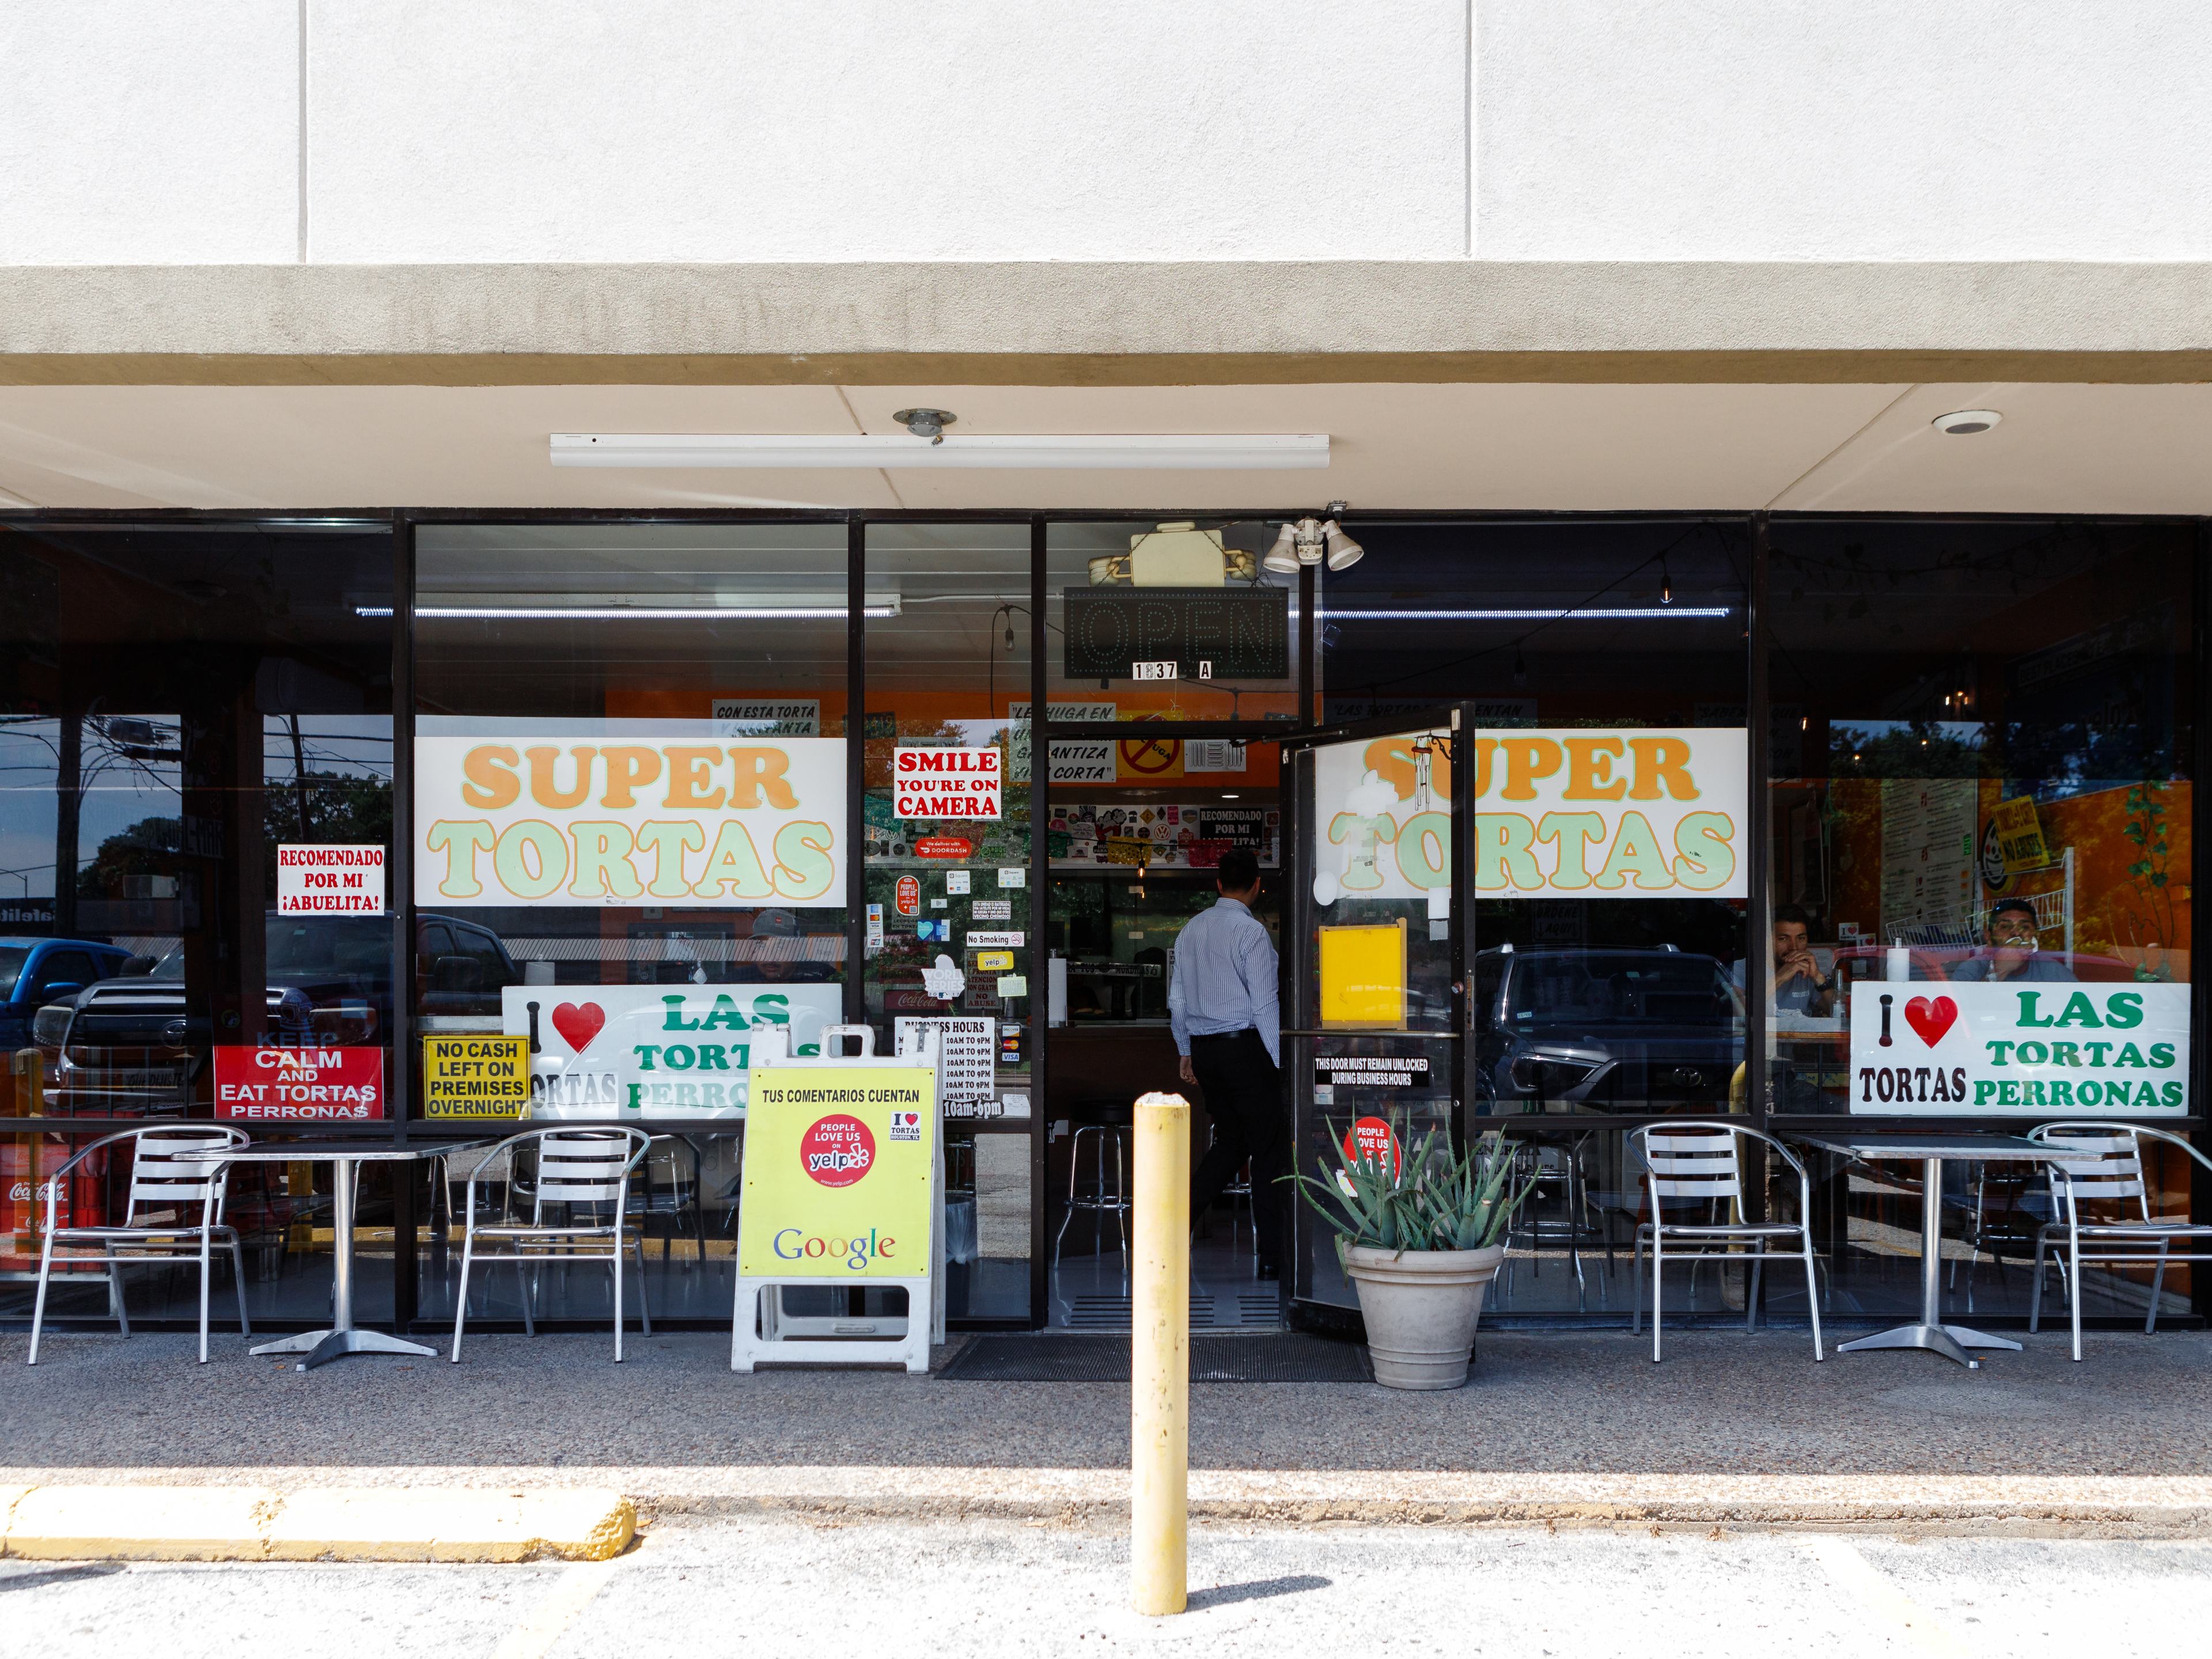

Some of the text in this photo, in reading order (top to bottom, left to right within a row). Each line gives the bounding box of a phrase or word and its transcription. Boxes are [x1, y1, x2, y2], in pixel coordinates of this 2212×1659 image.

[1081, 602, 1271, 664] OPEN
[1201, 663, 1209, 677] A
[717, 706, 815, 718] CON ESTA TORTA
[1013, 707, 1113, 719] "LEHUGA EN
[1017, 747, 1108, 759] GANTIZA
[899, 752, 997, 772] SMILE
[1363, 736, 1702, 802] SUPER
[461, 744, 800, 810] SUPER
[897, 780, 998, 791] YOU'RE ON
[897, 797, 997, 816] CAMERA
[1201, 811, 1262, 821] RECOMENDADO
[1215, 825, 1250, 834] POR MI
[281, 850, 383, 866] RECOMENDADO
[1327, 810, 1736, 891] TORTAS
[426, 819, 835, 900] TORTAS
[305, 873, 362, 888] POR MI
[283, 896, 378, 911] ¡ABUELITA!
[979, 935, 1009, 945] Smoking
[925, 980, 965, 991] SERIES
[662, 994, 790, 1031] LAS
[2016, 991, 2143, 1029] LAS
[527, 1001, 540, 1054] I
[953, 1022, 984, 1033] HOURS
[1878, 994, 1893, 1047] I
[257, 1032, 339, 1049] KEEP
[977, 1037, 990, 1045] 9PM
[437, 1043, 517, 1058] NO CASH
[1986, 1041, 2176, 1069] TORTAS
[256, 1051, 342, 1069] CALM
[1316, 1058, 1428, 1071] THIS DOOR MUST REMAIN UNLOCKED
[277, 1070, 318, 1081] AND
[439, 1062, 514, 1076] LEFT ON
[977, 1070, 990, 1078] 9PM
[1332, 1073, 1411, 1085] DURING BUSINESS HOURS
[1859, 1067, 1966, 1103] TORTAS
[221, 1085, 376, 1101] EAT TORTAS
[430, 1081, 524, 1096] PREMISES
[531, 1074, 616, 1109] ORTAS
[627, 1082, 747, 1109] PERRO
[763, 1089, 919, 1103] TUS COMENTARIOS CUENTAN
[1974, 1081, 2183, 1108] PERRONAS
[231, 1106, 369, 1119] PERRONAS
[429, 1099, 527, 1115] OVERNIGHT
[944, 1100, 1001, 1119] 10am-6pm
[894, 1114, 901, 1125] I
[815, 1133, 861, 1141] LOVE US
[1357, 1127, 1384, 1137] PEOPLE
[1358, 1138, 1389, 1149] OVE US
[810, 1151, 849, 1170] yelp
[9, 1182, 66, 1201] Coca-Coa
[774, 1228, 896, 1270] Google
